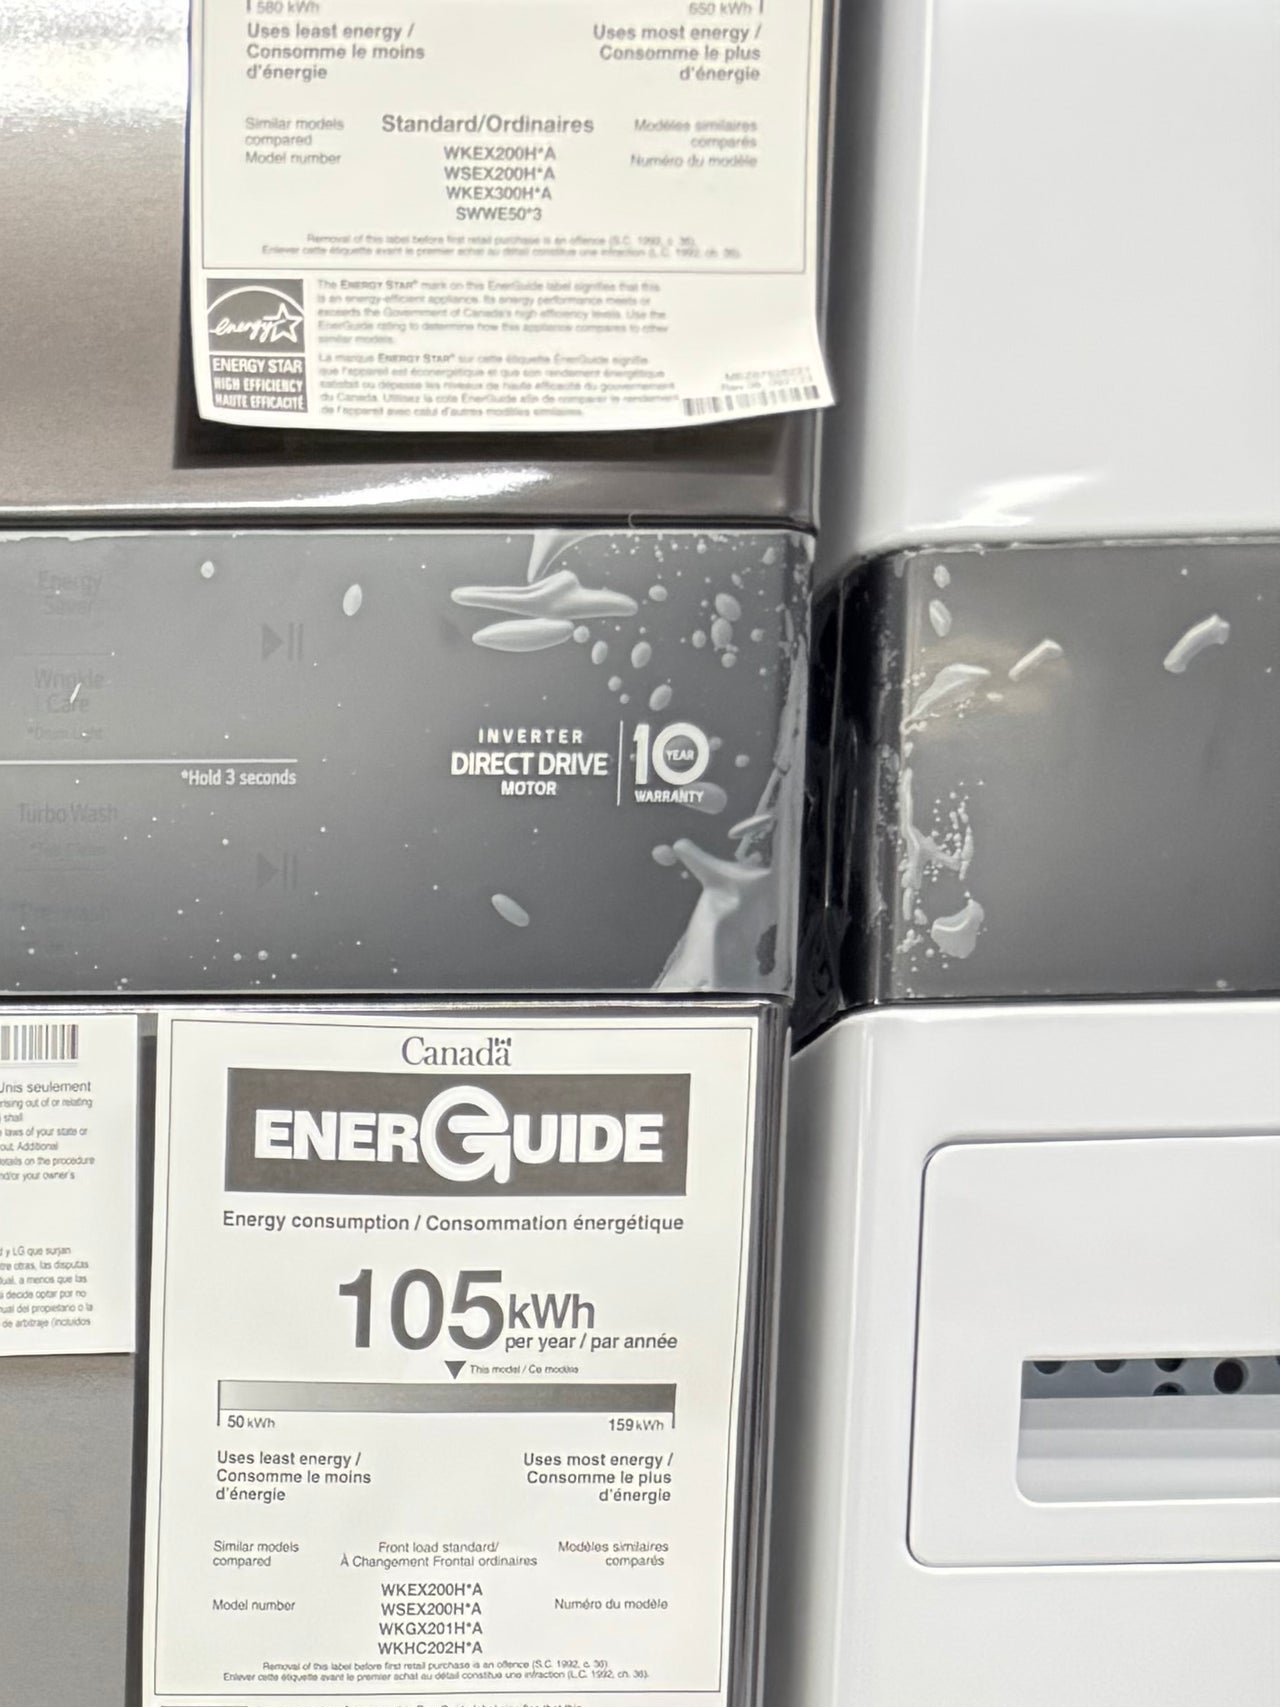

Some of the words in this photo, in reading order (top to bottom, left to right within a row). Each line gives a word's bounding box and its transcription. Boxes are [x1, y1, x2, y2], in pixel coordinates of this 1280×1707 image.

[257, 0, 284, 14] 580
[288, 0, 320, 13] kWh
[720, 1, 752, 15] kWh
[248, 22, 290, 39] Uses
[296, 22, 337, 38] least
[343, 26, 402, 42] energy
[593, 24, 636, 40] Uses
[641, 25, 685, 40] most
[690, 28, 750, 43] energy
[246, 43, 346, 59] Consomme
[352, 43, 367, 59] le
[372, 44, 425, 59] moins
[599, 44, 699, 61] Consomme
[705, 44, 719, 61] le
[725, 45, 761, 64] plus
[246, 64, 327, 83] d'énergie
[679, 66, 760, 84] d'énergie
[245, 117, 292, 130] Similar
[296, 118, 344, 131] models
[382, 114, 594, 133] Standard/Ordinaires
[245, 134, 312, 148] compared
[246, 151, 286, 164] Model
[291, 153, 341, 164] number
[212, 357, 265, 373] ENERGY
[267, 358, 303, 374] STAR
[213, 376, 240, 391] HIGH
[244, 377, 304, 393] EFFICIENCY
[479, 728, 583, 744] INVERTER
[633, 722, 709, 785] 10
[665, 749, 695, 761] YEAR
[451, 751, 535, 775] DIRECT
[539, 752, 608, 775] DRIVE
[226, 768, 235, 785] 3
[240, 769, 296, 785] seconds
[501, 780, 557, 795] MOTOR
[634, 788, 706, 803] WARRANTY
[402, 1036, 511, 1066] Canada
[27, 1081, 91, 1094] seulement
[254, 1085, 664, 1184] ENERGUIDE
[224, 1210, 286, 1231] Energy
[292, 1214, 409, 1233] consumption
[426, 1215, 567, 1231] Consommation
[574, 1214, 684, 1234] énergétique
[338, 1268, 504, 1350] 105
[509, 1294, 595, 1329] kWh
[505, 1337, 533, 1353] per
[538, 1337, 576, 1352] year
[591, 1337, 620, 1352] par
[624, 1333, 678, 1348] année
[470, 1365, 489, 1374] This
[228, 1415, 244, 1428] 50
[247, 1418, 275, 1428] kWh
[608, 1418, 634, 1432] 159
[635, 1419, 665, 1432] kWh
[218, 1450, 254, 1464] Uses
[260, 1451, 295, 1465] least
[300, 1455, 351, 1469] energy
[524, 1453, 561, 1466] Uses
[567, 1454, 606, 1466] most
[610, 1456, 663, 1469] energy
[217, 1469, 302, 1483] Consomme
[308, 1470, 320, 1483] le
[325, 1470, 371, 1484] moins
[527, 1470, 615, 1485] Consomme
[619, 1470, 633, 1484] le
[639, 1471, 671, 1488] plus
[216, 1487, 285, 1504] d'énergie
[599, 1488, 671, 1505] d'énergie
[213, 1540, 254, 1552] Similar
[257, 1542, 299, 1552] models
[379, 1542, 409, 1553] Front
[413, 1542, 438, 1553] load
[442, 1542, 499, 1553] standard/
[558, 1541, 609, 1552] Modèles
[613, 1541, 669, 1552] similaires
[213, 1556, 271, 1569] compared
[340, 1553, 349, 1567] À
[352, 1555, 429, 1570] Changement
[433, 1556, 474, 1567] Frontal
[478, 1556, 537, 1566] ordinaires
[606, 1555, 664, 1568] comparés
[212, 1599, 248, 1611] Model
[252, 1600, 295, 1611] number
[555, 1598, 602, 1610] Numéro
[606, 1599, 620, 1609] du
[624, 1599, 668, 1609] modèle
